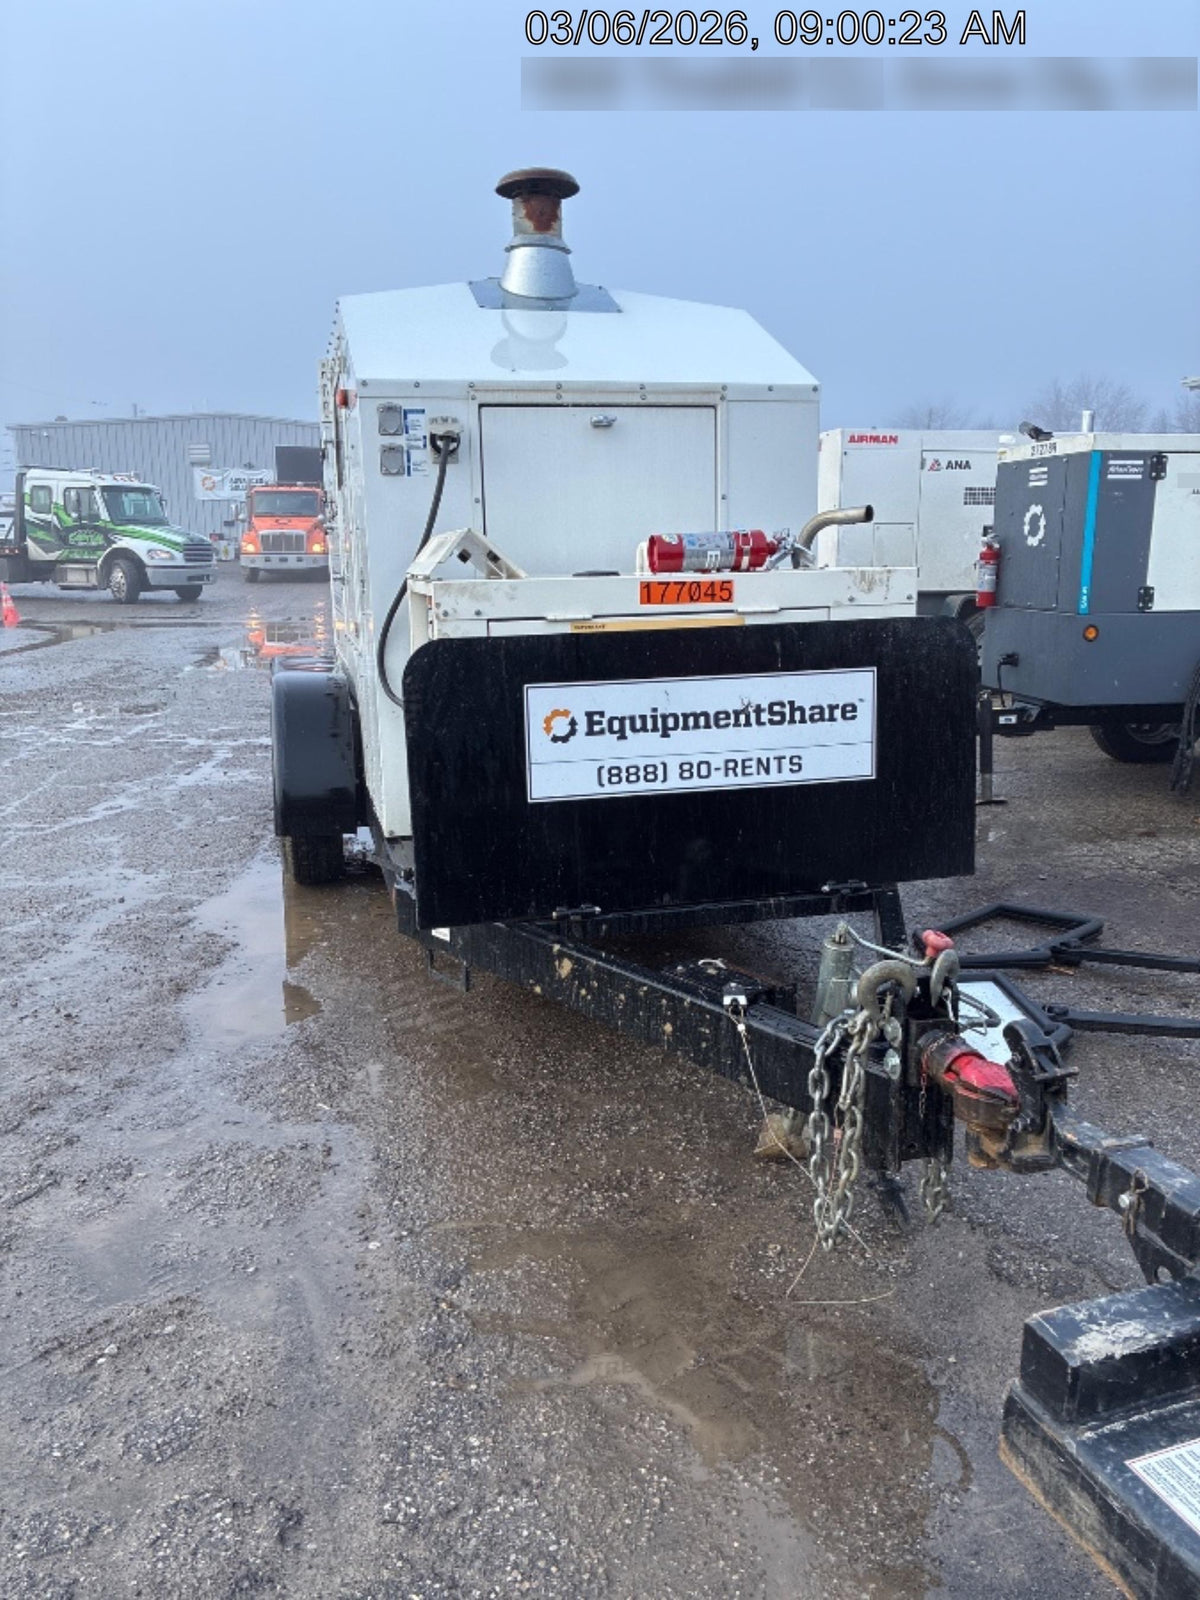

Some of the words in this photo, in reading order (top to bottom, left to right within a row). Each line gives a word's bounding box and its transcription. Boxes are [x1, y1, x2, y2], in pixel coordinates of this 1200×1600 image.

[847, 434, 899, 445] AIRMAN
[945, 459, 972, 470] ANA
[641, 580, 733, 603] 177045
[584, 700, 860, 741] EquipmentShare
[596, 763, 668, 787] (888)
[678, 754, 804, 781] 80-RENTS
